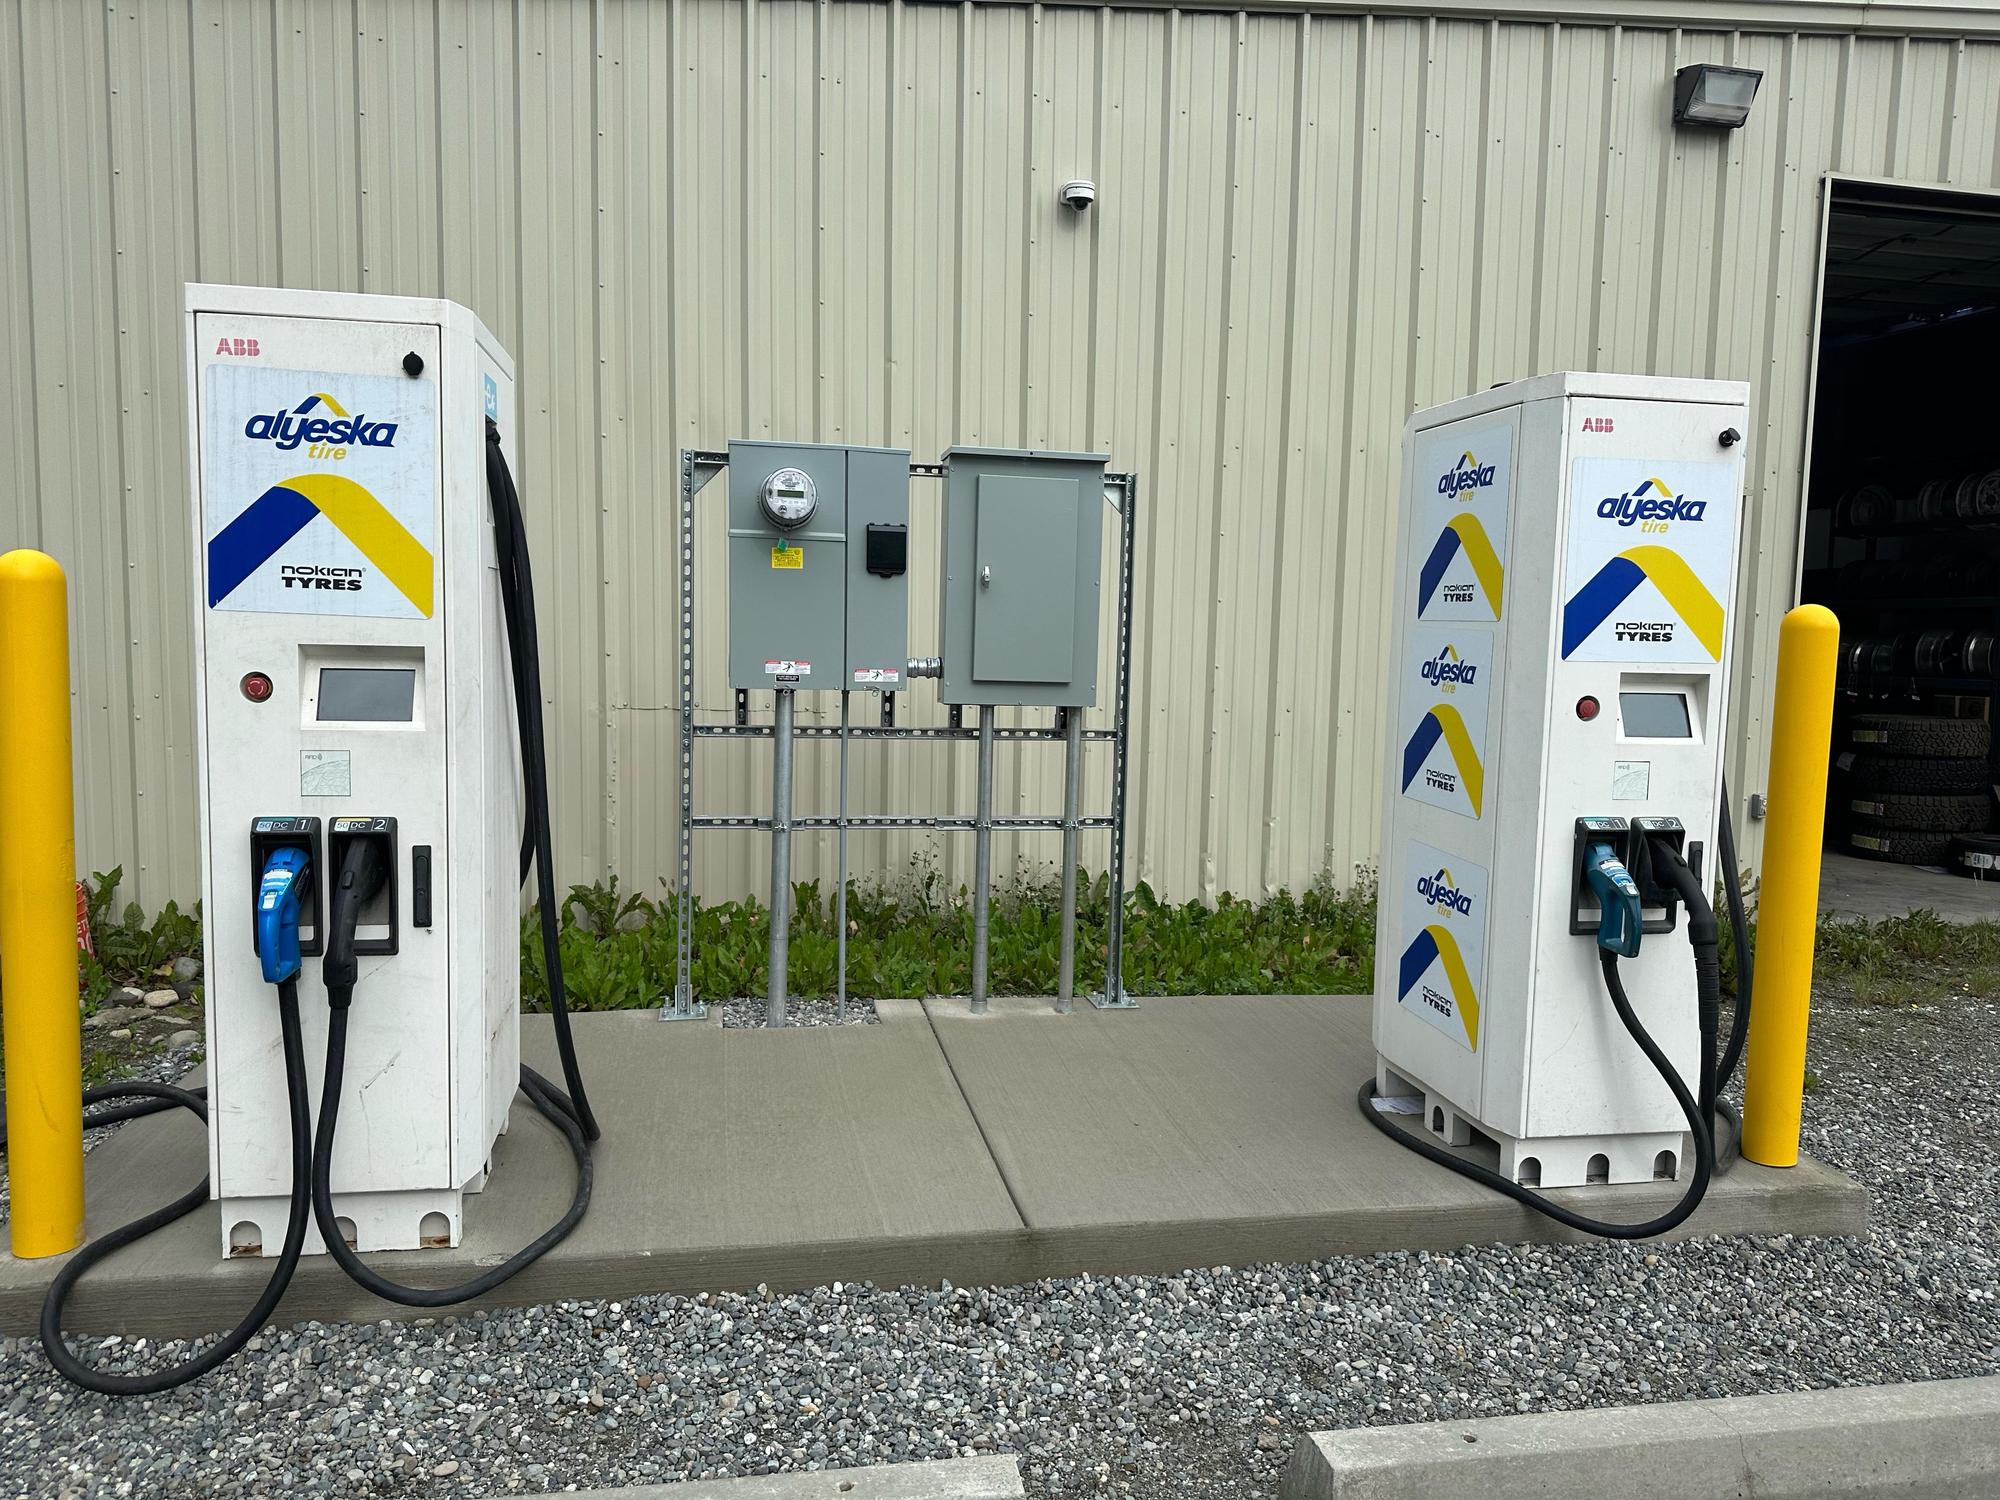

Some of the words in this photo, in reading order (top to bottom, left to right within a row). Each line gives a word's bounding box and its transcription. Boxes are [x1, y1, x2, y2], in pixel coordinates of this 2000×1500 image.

[216, 338, 260, 356] ABB
[245, 409, 398, 450] alyeska
[1582, 418, 1614, 433] ABB
[308, 442, 347, 460] tire
[1438, 462, 1496, 498] alyeska
[1459, 490, 1474, 502] tire
[1597, 492, 1707, 526] alyeska
[1641, 519, 1669, 533] tire
[281, 576, 363, 591] TYRES
[1443, 593, 1473, 602] TYRES
[1615, 632, 1673, 642] TYRES
[1421, 656, 1477, 686] alyeska
[1441, 682, 1456, 694] tire
[1426, 777, 1455, 792] TYRES
[300, 819, 307, 830] 1
[374, 819, 386, 830] 2
[1668, 819, 1680, 828] 2
[1417, 876, 1473, 916] alyeska
[1436, 903, 1452, 918] tire
[1422, 993, 1451, 1017] TYRES
